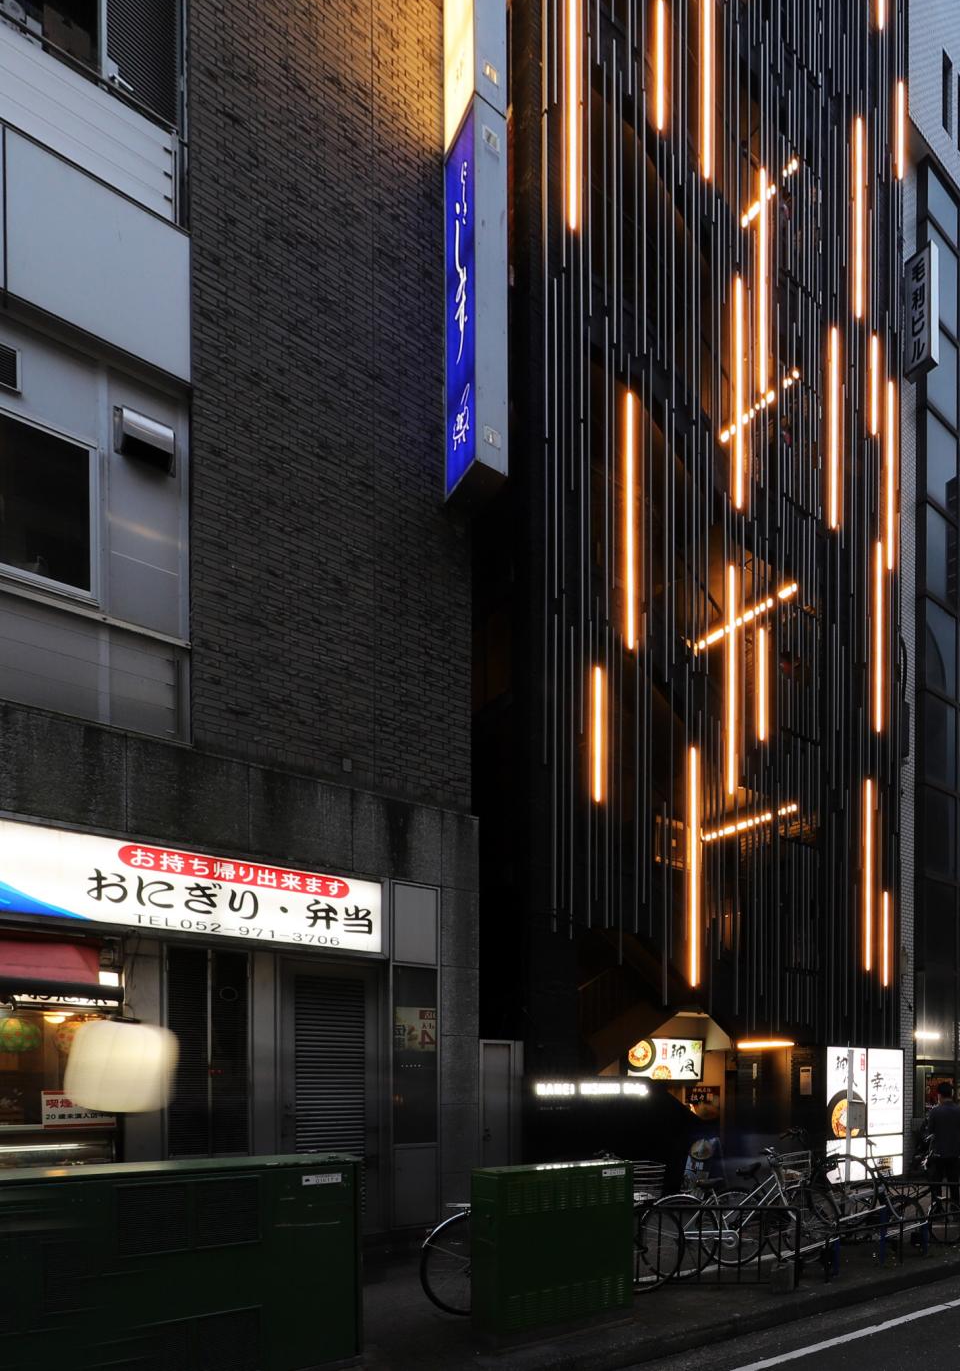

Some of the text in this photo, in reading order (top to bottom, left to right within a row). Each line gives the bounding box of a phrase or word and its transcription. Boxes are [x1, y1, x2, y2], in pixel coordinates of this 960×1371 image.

[911, 256, 926, 364] 毛利ビル
[86, 867, 374, 935] おにぎり・弁当
[130, 848, 345, 897] お持ち帰り出来ます
[871, 1094, 900, 1105] ラーメン
